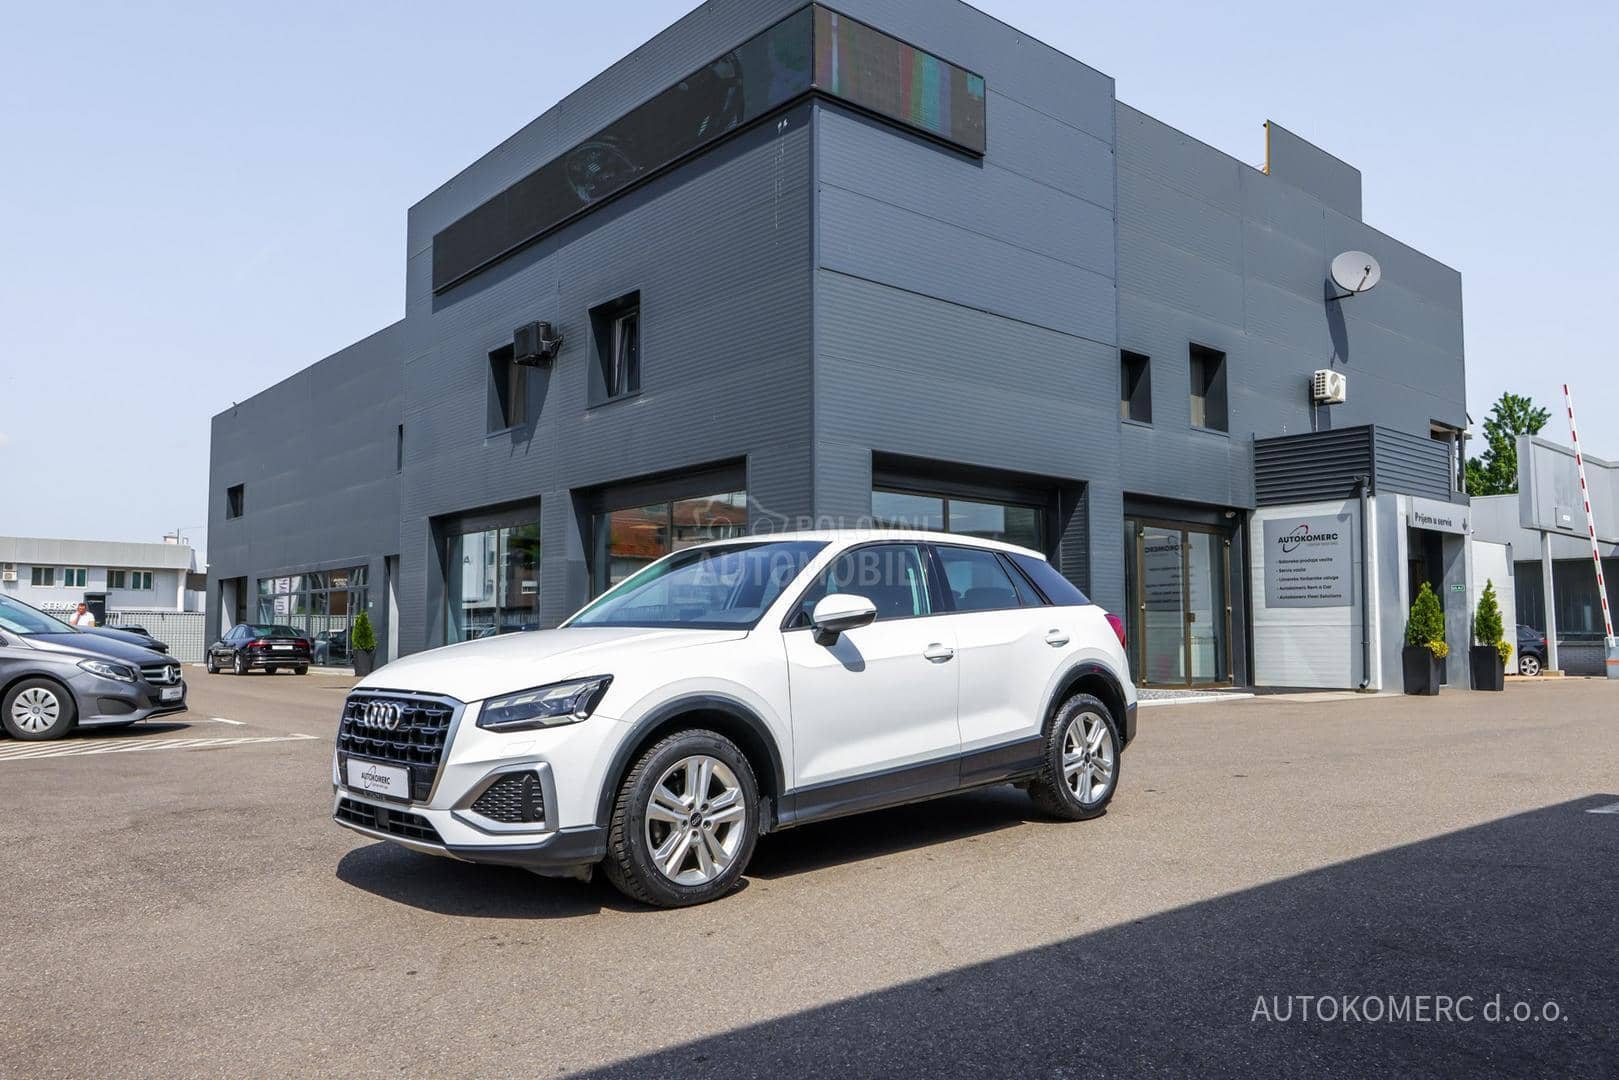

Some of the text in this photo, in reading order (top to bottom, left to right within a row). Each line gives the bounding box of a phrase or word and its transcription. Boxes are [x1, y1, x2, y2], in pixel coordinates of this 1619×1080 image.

[1415, 512, 1432, 525] Prijem
[1278, 533, 1338, 544] AUTOKOMERC
[361, 772, 390, 784] AUTOKOMERC
